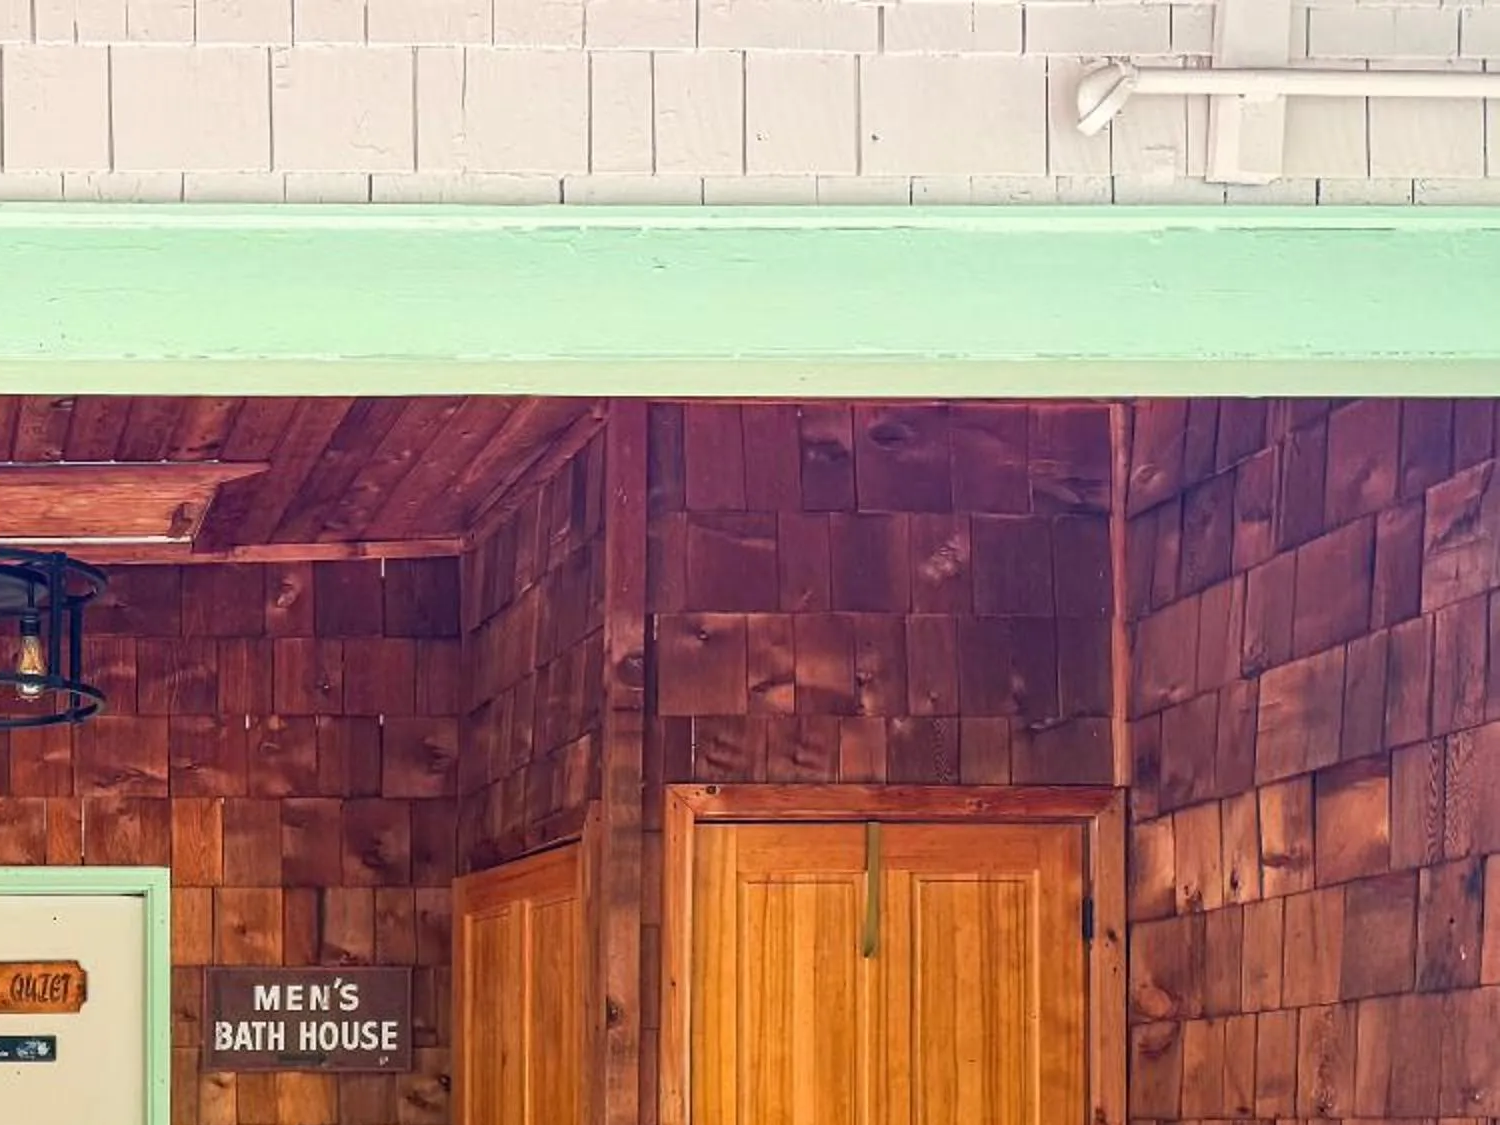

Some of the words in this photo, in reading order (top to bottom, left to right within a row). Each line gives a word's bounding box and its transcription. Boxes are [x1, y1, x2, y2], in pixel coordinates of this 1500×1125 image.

[253, 977, 360, 1011] MEN'S
[214, 1021, 285, 1051] BATH
[300, 1020, 398, 1051] HOUSE
